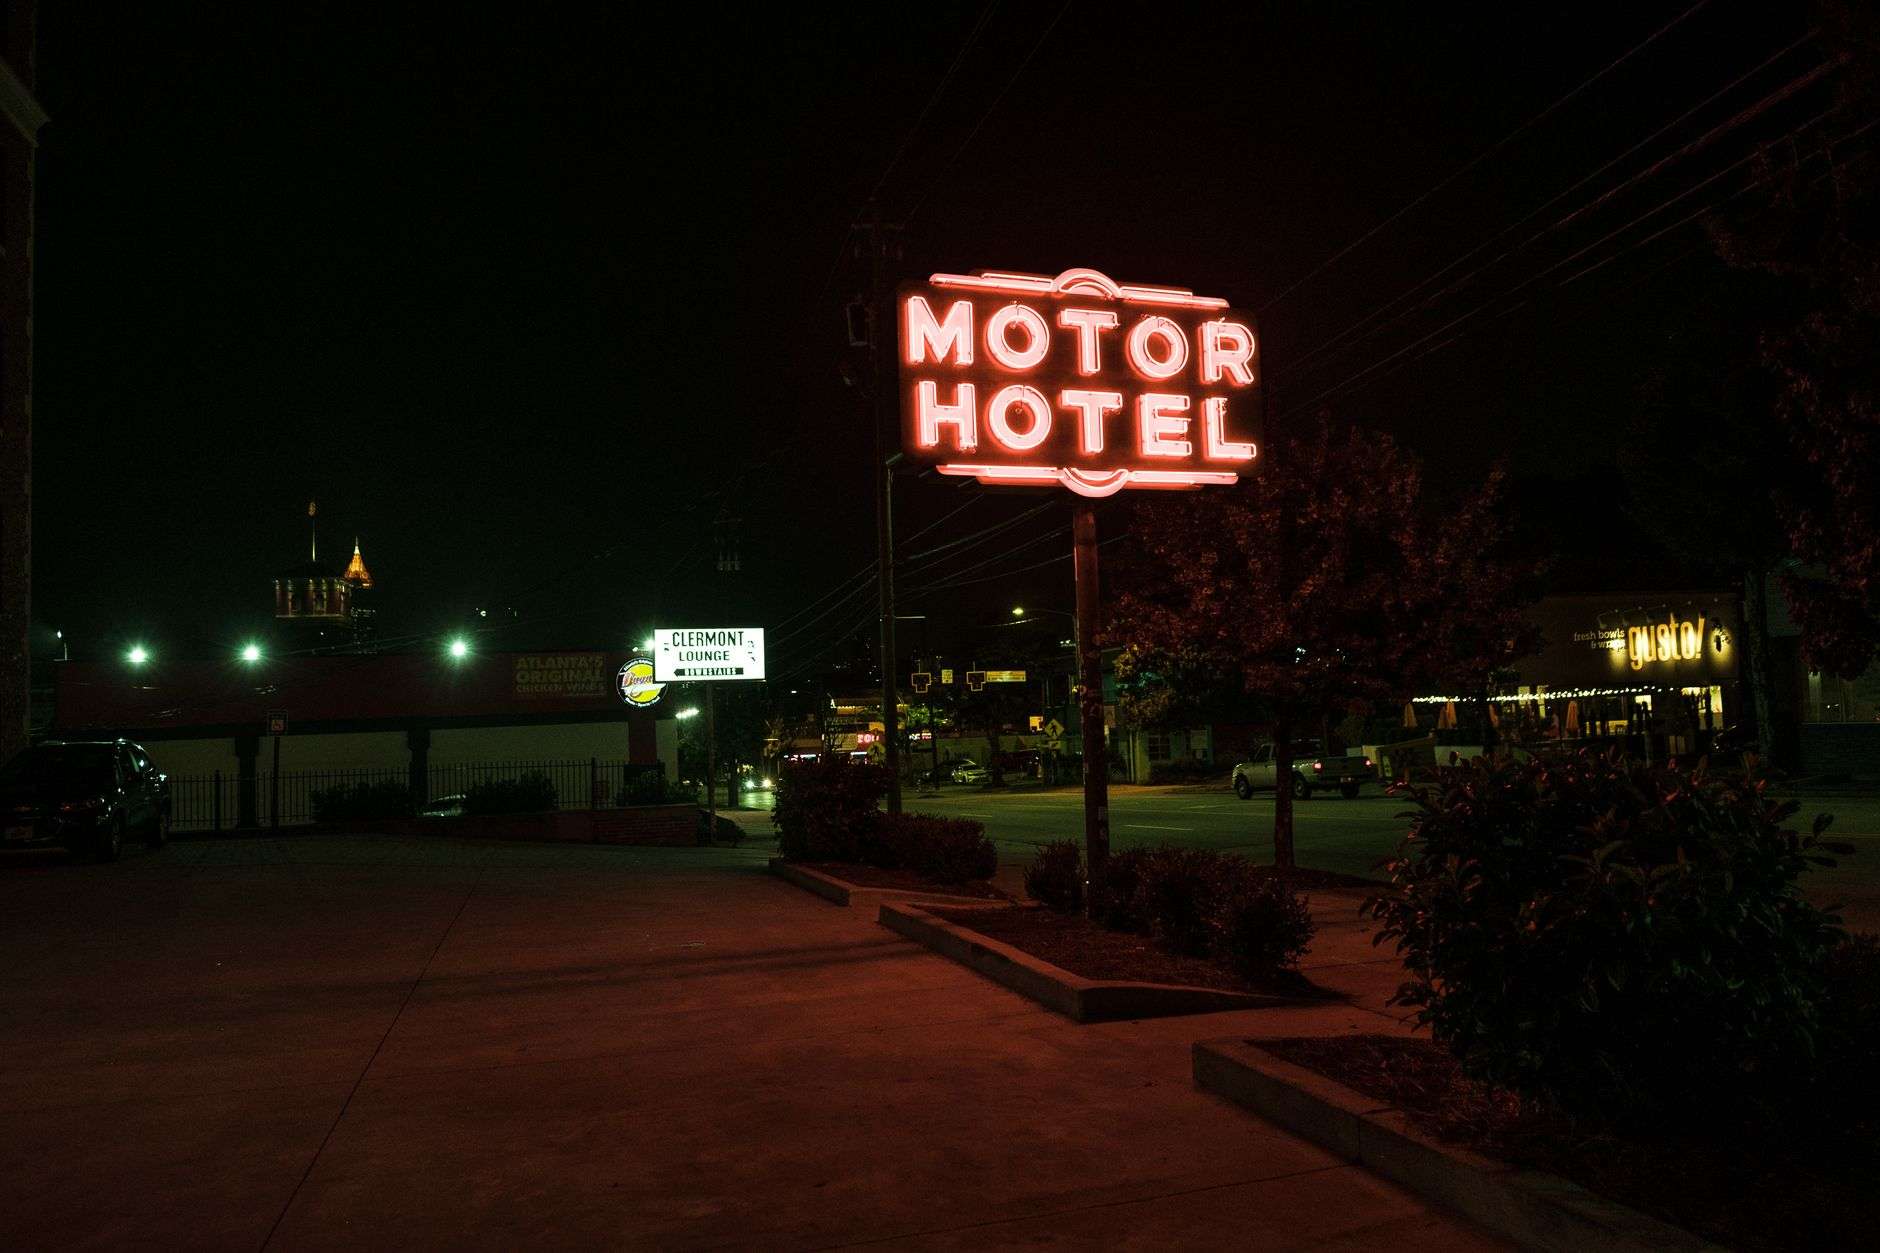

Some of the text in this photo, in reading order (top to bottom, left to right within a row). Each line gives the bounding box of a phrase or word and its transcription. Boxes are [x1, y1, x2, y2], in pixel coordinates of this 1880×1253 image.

[905, 296, 1255, 384] MOTOR
[916, 381, 1256, 459] HOTEL
[672, 631, 744, 647] CLERMONT
[1574, 628, 1625, 642] fresh bowls
[1628, 613, 1706, 671] gusto!
[515, 655, 604, 670] ATLANTA'S
[679, 650, 730, 662] LOUNGE
[515, 669, 606, 684] ORIGINAL
